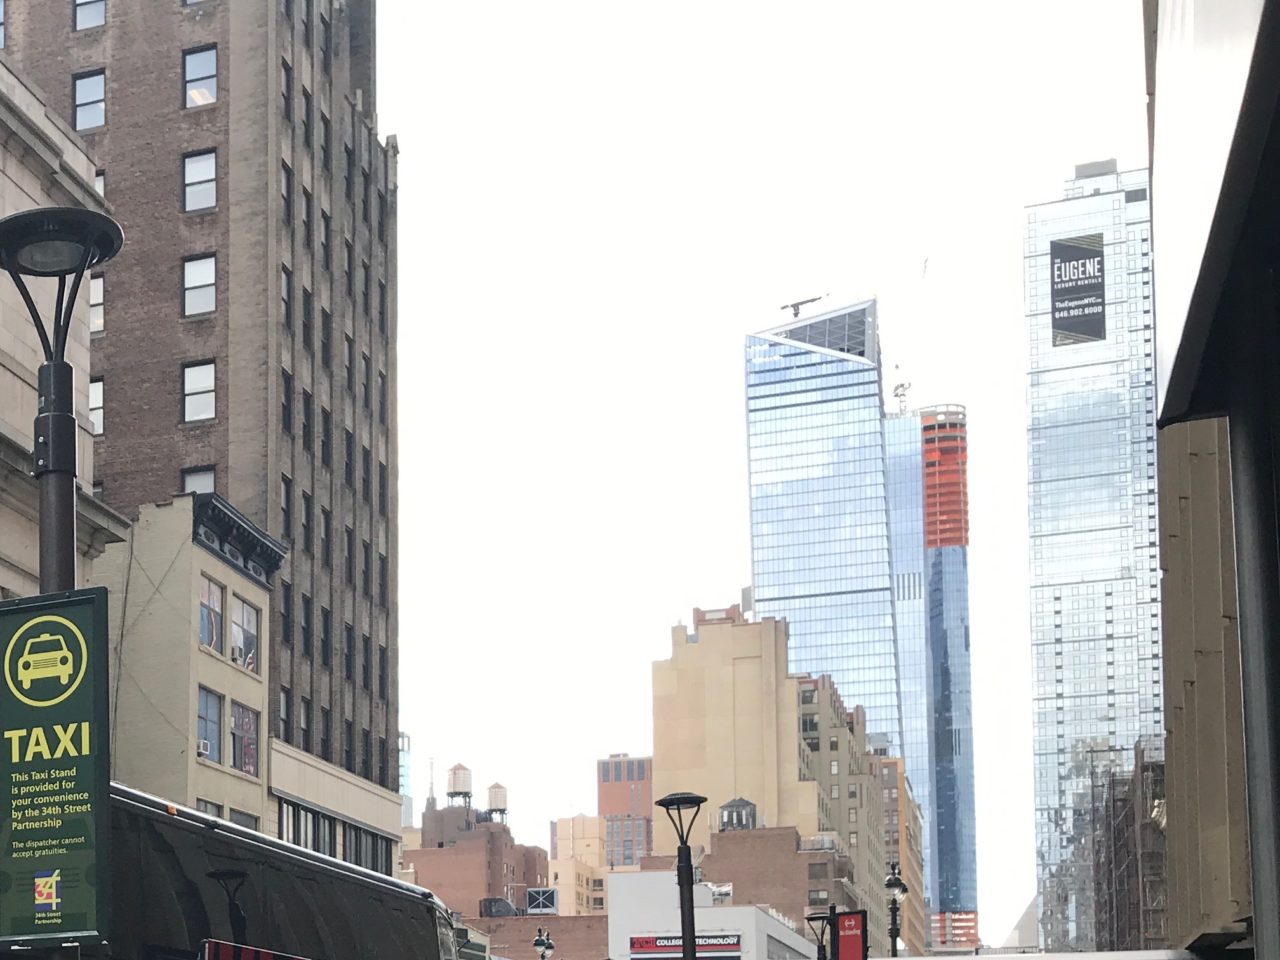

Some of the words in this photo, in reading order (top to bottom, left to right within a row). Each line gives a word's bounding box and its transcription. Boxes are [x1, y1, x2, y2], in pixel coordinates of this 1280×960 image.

[1054, 257, 1101, 282] EUGENE
[4, 721, 90, 763] TAXI
[11, 773, 29, 782] This
[31, 770, 48, 780] Taxi
[50, 766, 77, 778] Stand
[11, 785, 18, 794] is
[20, 781, 60, 795] provided
[62, 780, 76, 789] for
[11, 798, 32, 808] your
[34, 792, 89, 804] convenience
[11, 809, 23, 820] by
[25, 807, 40, 817] the
[41, 805, 62, 816] 34th
[64, 803, 92, 813] Street
[11, 818, 62, 830] Partnership
[12, 841, 24, 849] The
[25, 838, 60, 848] dispatcher
[61, 836, 85, 845] cannot
[12, 850, 34, 859] accept
